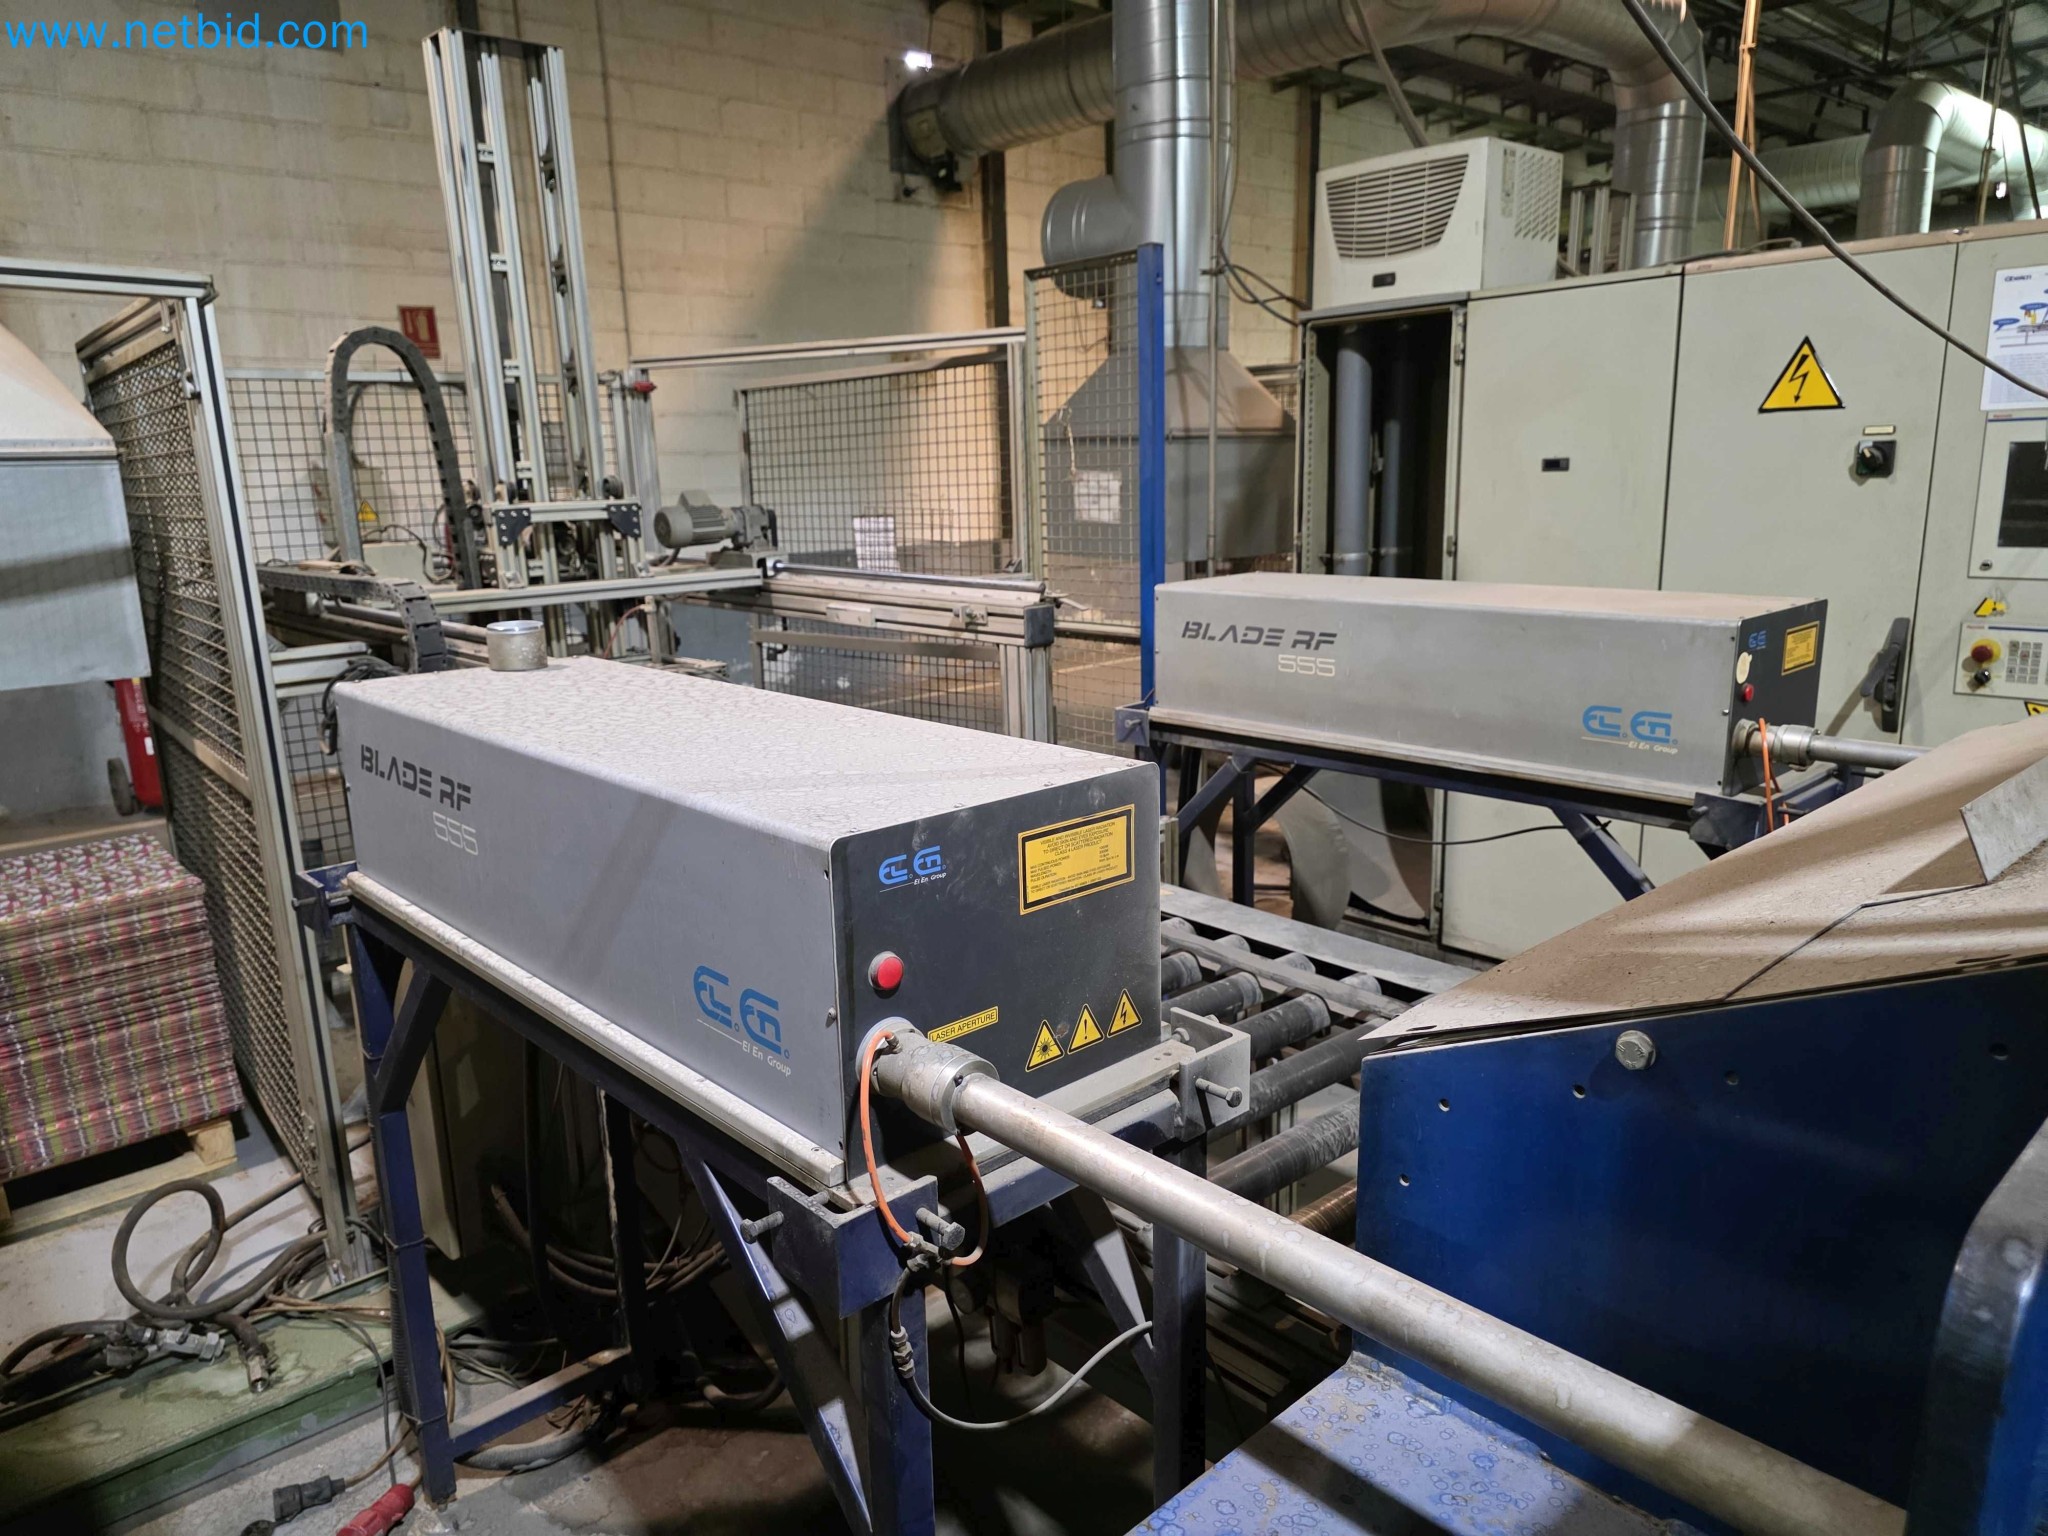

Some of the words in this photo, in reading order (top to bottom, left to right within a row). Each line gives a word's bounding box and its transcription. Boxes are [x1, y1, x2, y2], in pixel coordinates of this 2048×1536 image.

[1181, 621, 1285, 647] BLADE
[1291, 630, 1338, 650] RF
[1653, 744, 1679, 755] Group
[361, 744, 432, 798] BLADE
[440, 775, 471, 811] RF
[930, 872, 947, 880] Group
[931, 1027, 956, 1042] LASER
[956, 1011, 996, 1033] APERTURE
[752, 1047, 764, 1060] En
[767, 1056, 792, 1077] Group
